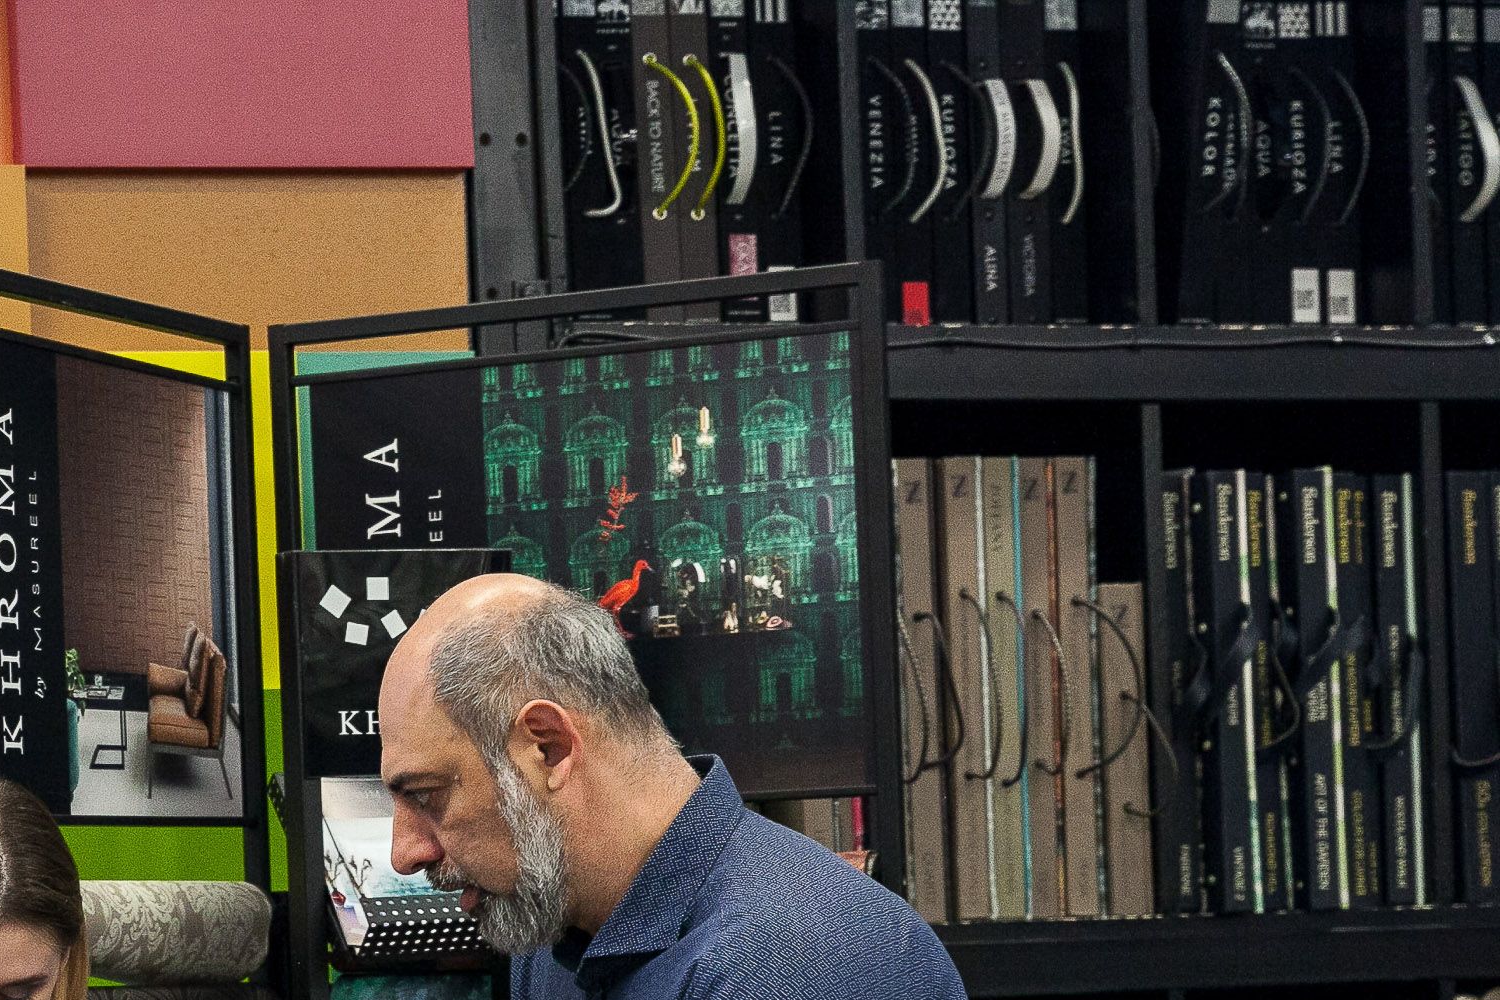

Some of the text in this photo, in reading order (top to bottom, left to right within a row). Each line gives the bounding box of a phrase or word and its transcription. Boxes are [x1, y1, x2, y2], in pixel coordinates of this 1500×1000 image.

[647, 80, 665, 192] BACK TO NATURE
[767, 110, 783, 166] LINA
[868, 95, 886, 189] VENEZIA
[1201, 96, 1222, 178] KOLOR
[1255, 119, 1272, 177] AQUA
[363, 438, 402, 539] MA
[28, 470, 47, 698] by MASUREEL
